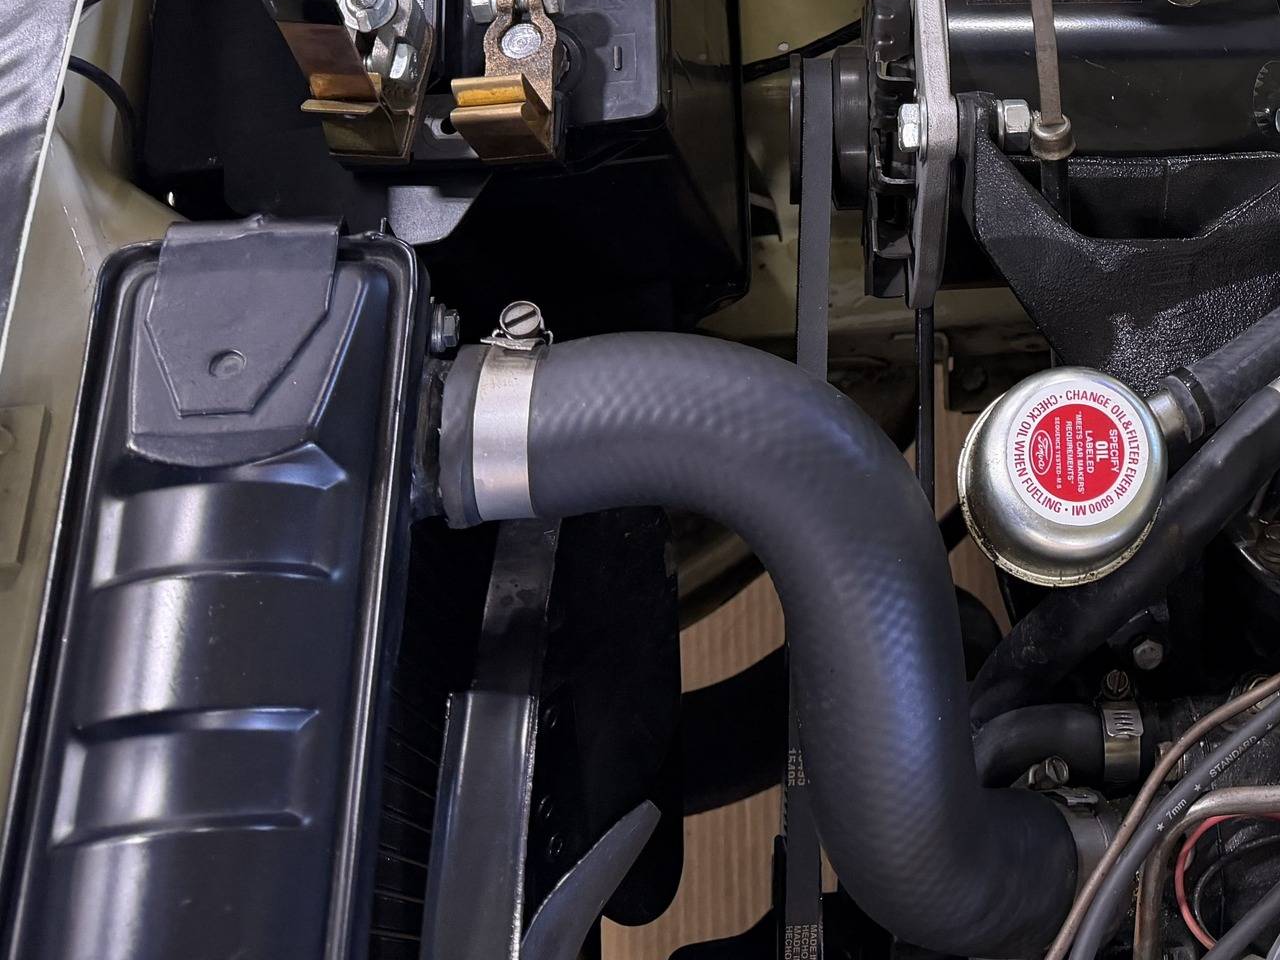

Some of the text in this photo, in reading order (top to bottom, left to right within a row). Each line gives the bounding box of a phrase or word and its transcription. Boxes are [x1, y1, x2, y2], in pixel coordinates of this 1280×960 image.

[1065, 390, 1112, 408] CHANGE
[1014, 394, 1062, 513] CHECK OIL WHEN FUELING
[1085, 430, 1094, 473] LABELED
[1095, 441, 1108, 462] OIL
[1109, 429, 1120, 473] SPECIFY
[1115, 467, 1136, 500] EVERY
[1072, 505, 1086, 516] MI
[1088, 495, 1115, 514] 6000
[1165, 798, 1188, 820] 7mm
[1209, 735, 1257, 779] STANDARD
[785, 926, 793, 960] HECHO
[793, 926, 801, 953] MADE
[801, 925, 809, 959] HECHO
[810, 925, 818, 953] MADE
